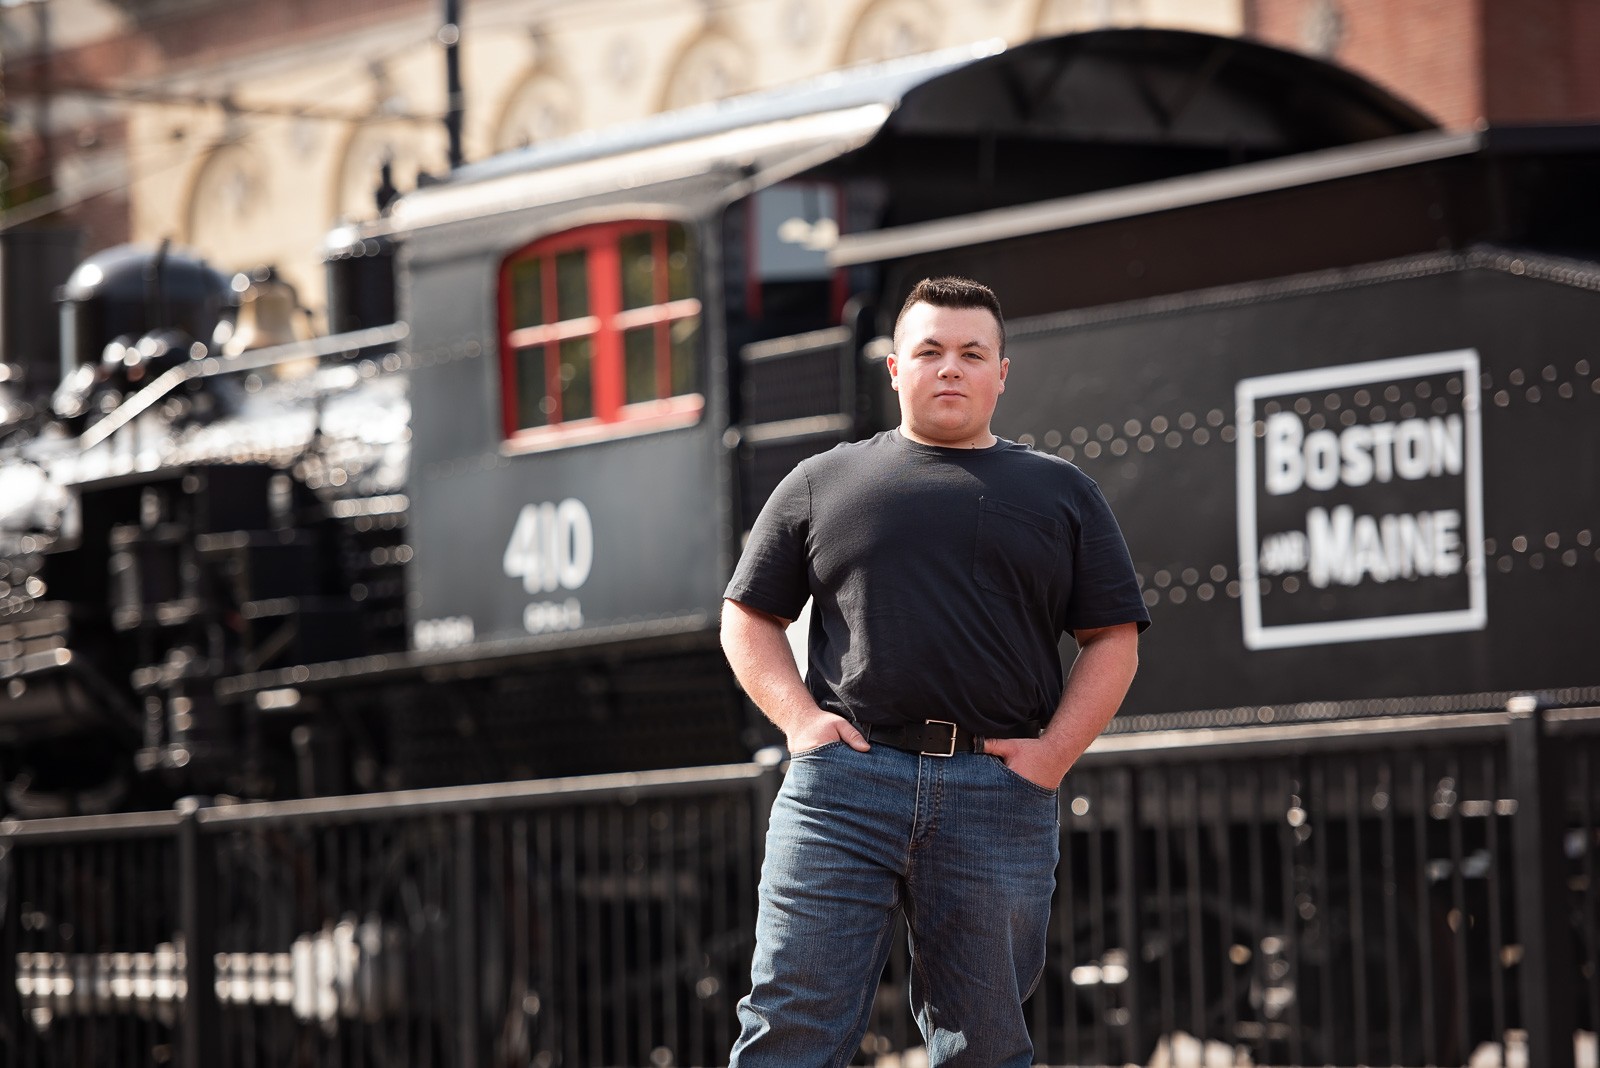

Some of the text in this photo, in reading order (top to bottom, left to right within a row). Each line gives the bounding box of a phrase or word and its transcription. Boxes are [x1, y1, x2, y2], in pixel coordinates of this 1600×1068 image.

[1265, 411, 1462, 495] BOSTON
[503, 497, 593, 594] 410
[1306, 504, 1461, 588] MAINE
